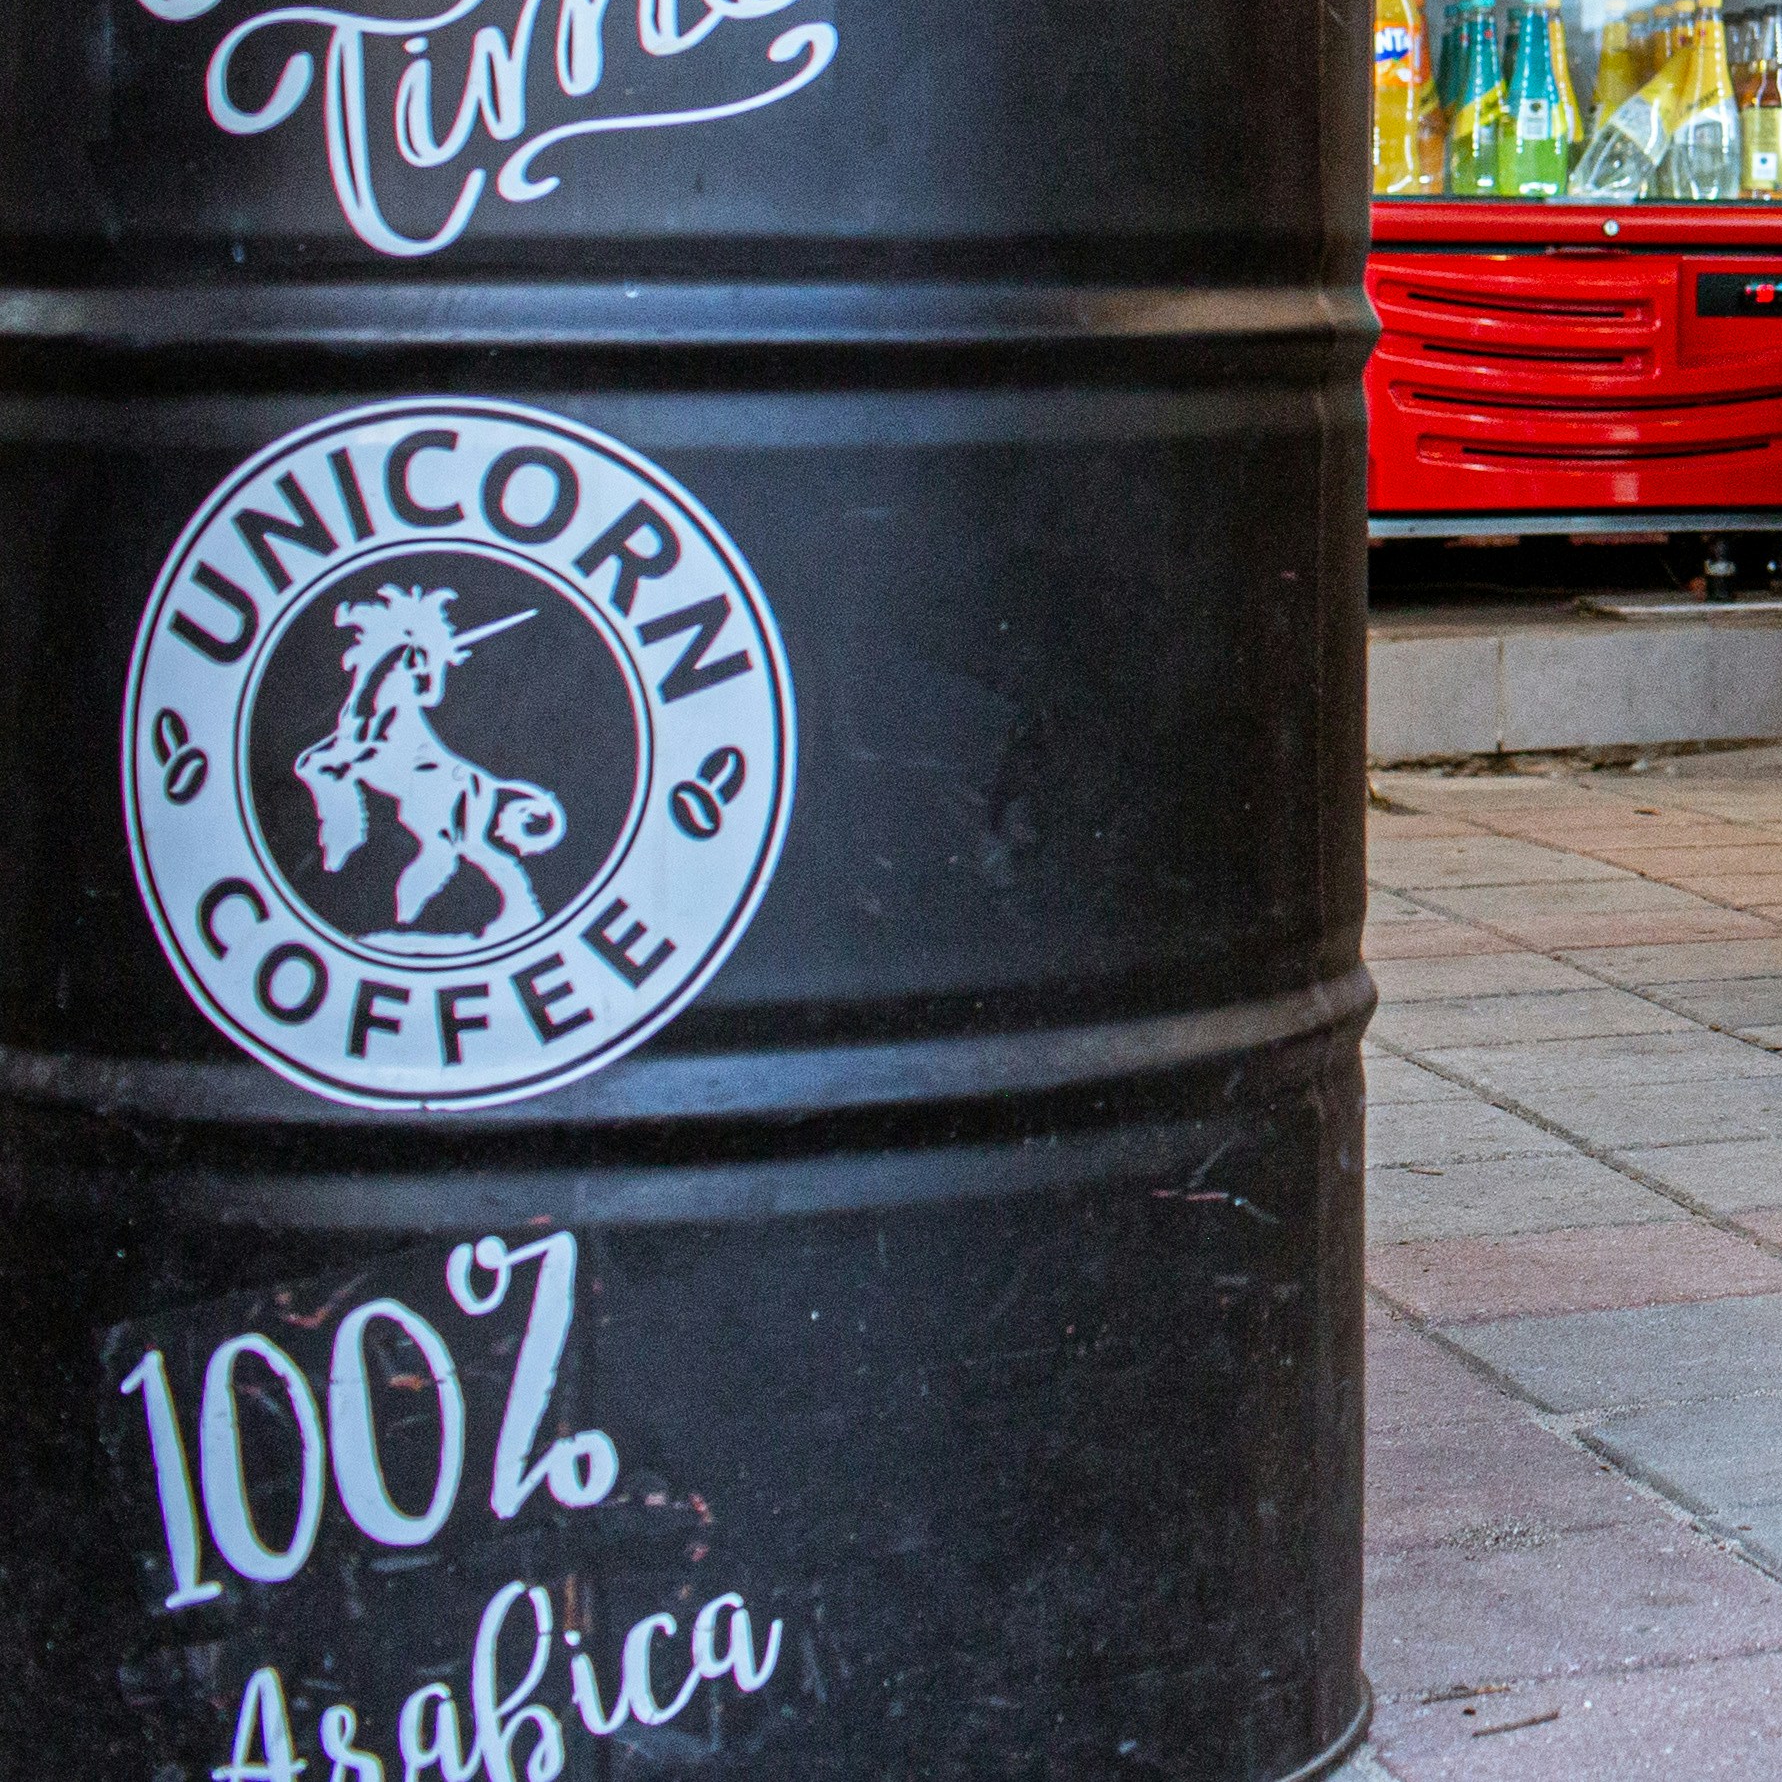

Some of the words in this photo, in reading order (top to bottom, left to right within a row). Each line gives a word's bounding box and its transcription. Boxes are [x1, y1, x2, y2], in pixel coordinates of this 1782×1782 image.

[168, 429, 753, 705] UNICORN
[195, 876, 676, 1066] COFFEE
[120, 1231, 620, 1609] 100%
